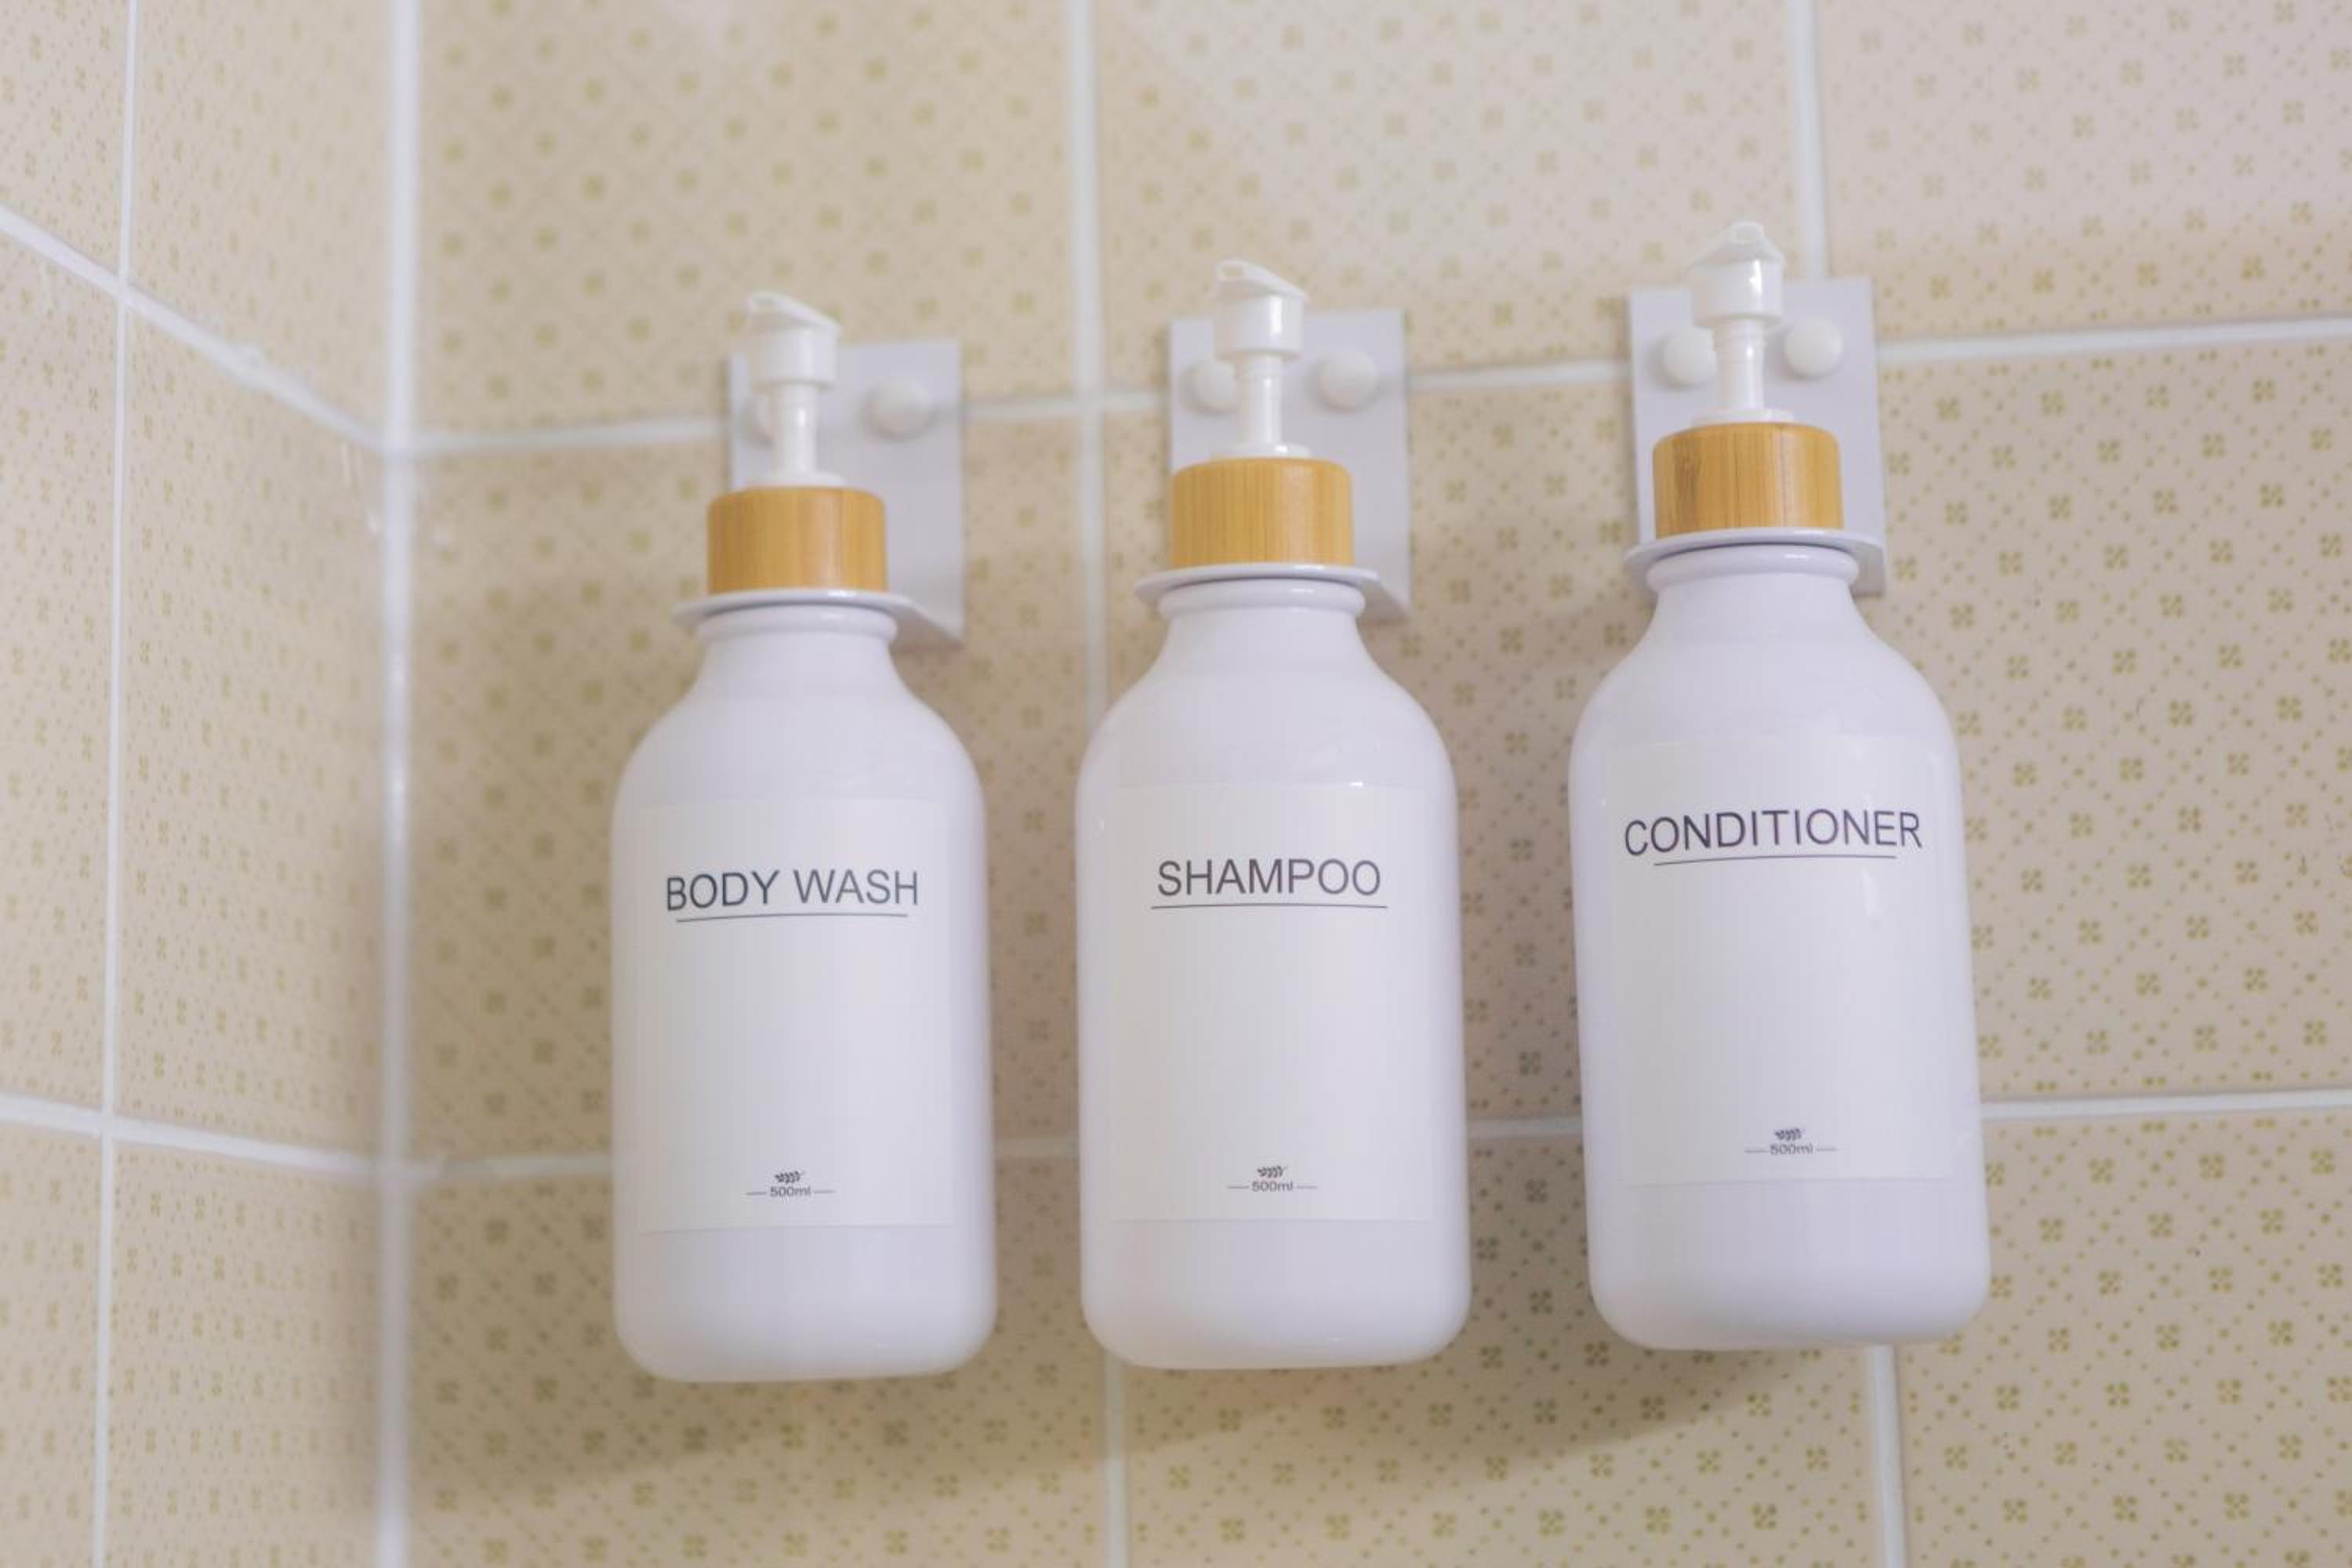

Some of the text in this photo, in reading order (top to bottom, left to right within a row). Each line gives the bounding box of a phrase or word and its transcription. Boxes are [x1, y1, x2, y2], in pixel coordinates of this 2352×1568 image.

[1624, 808, 1922, 857] CONDITIONER
[1157, 858, 1381, 897] SHAMPOO
[666, 869, 918, 913] BODY WASH
[1769, 1142, 1814, 1156] 500ml
[769, 1185, 811, 1198] 500ml
[1251, 1180, 1294, 1192] 500ml
